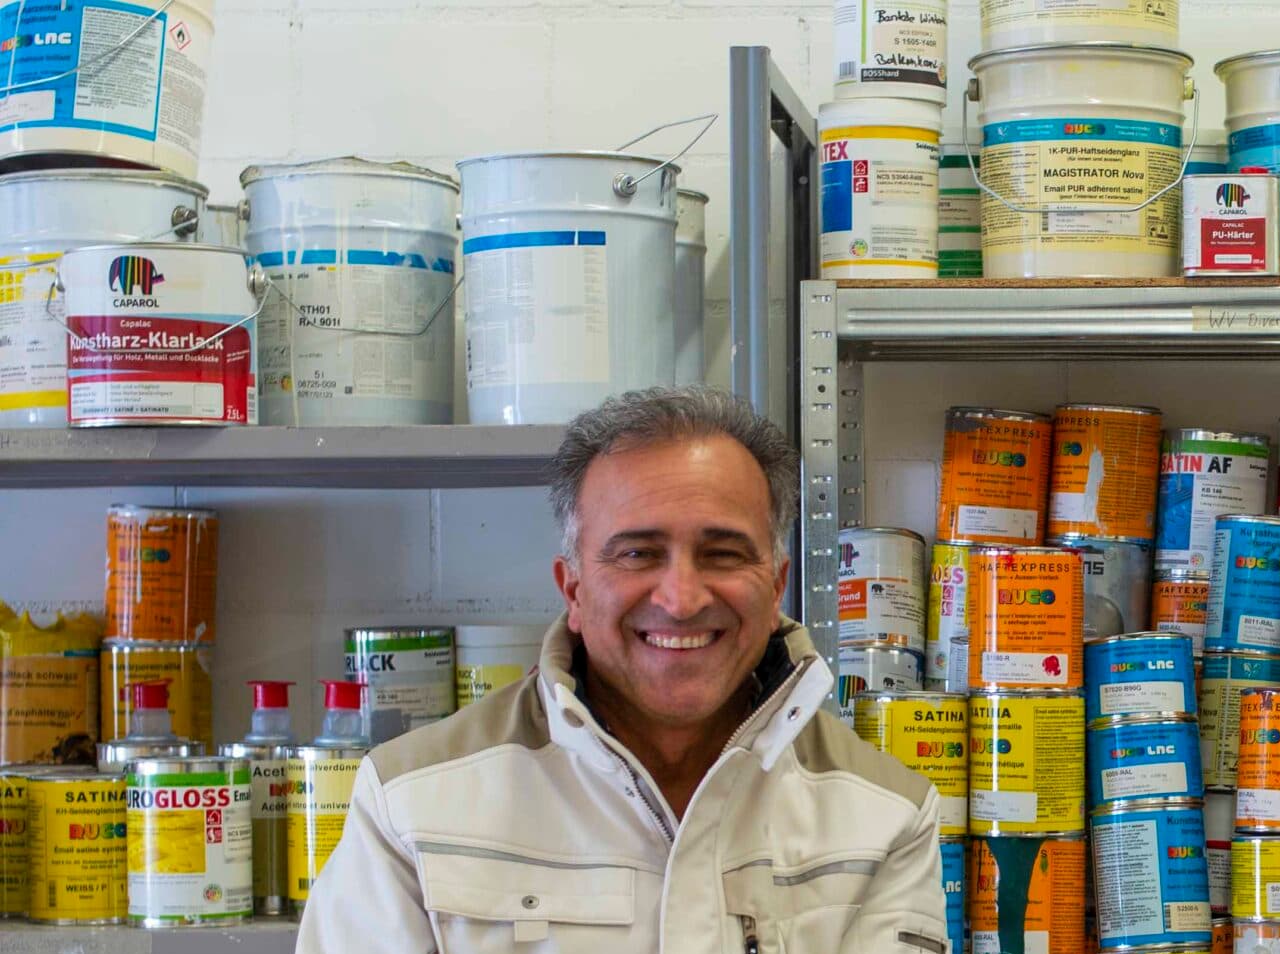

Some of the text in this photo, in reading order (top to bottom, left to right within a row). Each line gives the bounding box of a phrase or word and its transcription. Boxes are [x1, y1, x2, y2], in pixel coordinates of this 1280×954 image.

[1048, 147, 1139, 158] 1K-PUR-Haftseidenglanz
[1044, 168, 1144, 180] MAGISTRATOR Nova
[1068, 185, 1084, 193] PUR
[1219, 208, 1248, 216] CAPAROL
[1212, 231, 1254, 240] PU-Härter
[113, 299, 159, 308] CAPAROL
[120, 320, 151, 328] Capalac
[973, 453, 1026, 467] RUCO
[1208, 457, 1232, 473] AF
[980, 563, 1070, 573] HAFTEXPRESS
[999, 590, 1056, 605] RUCO
[915, 710, 964, 721] SATINA
